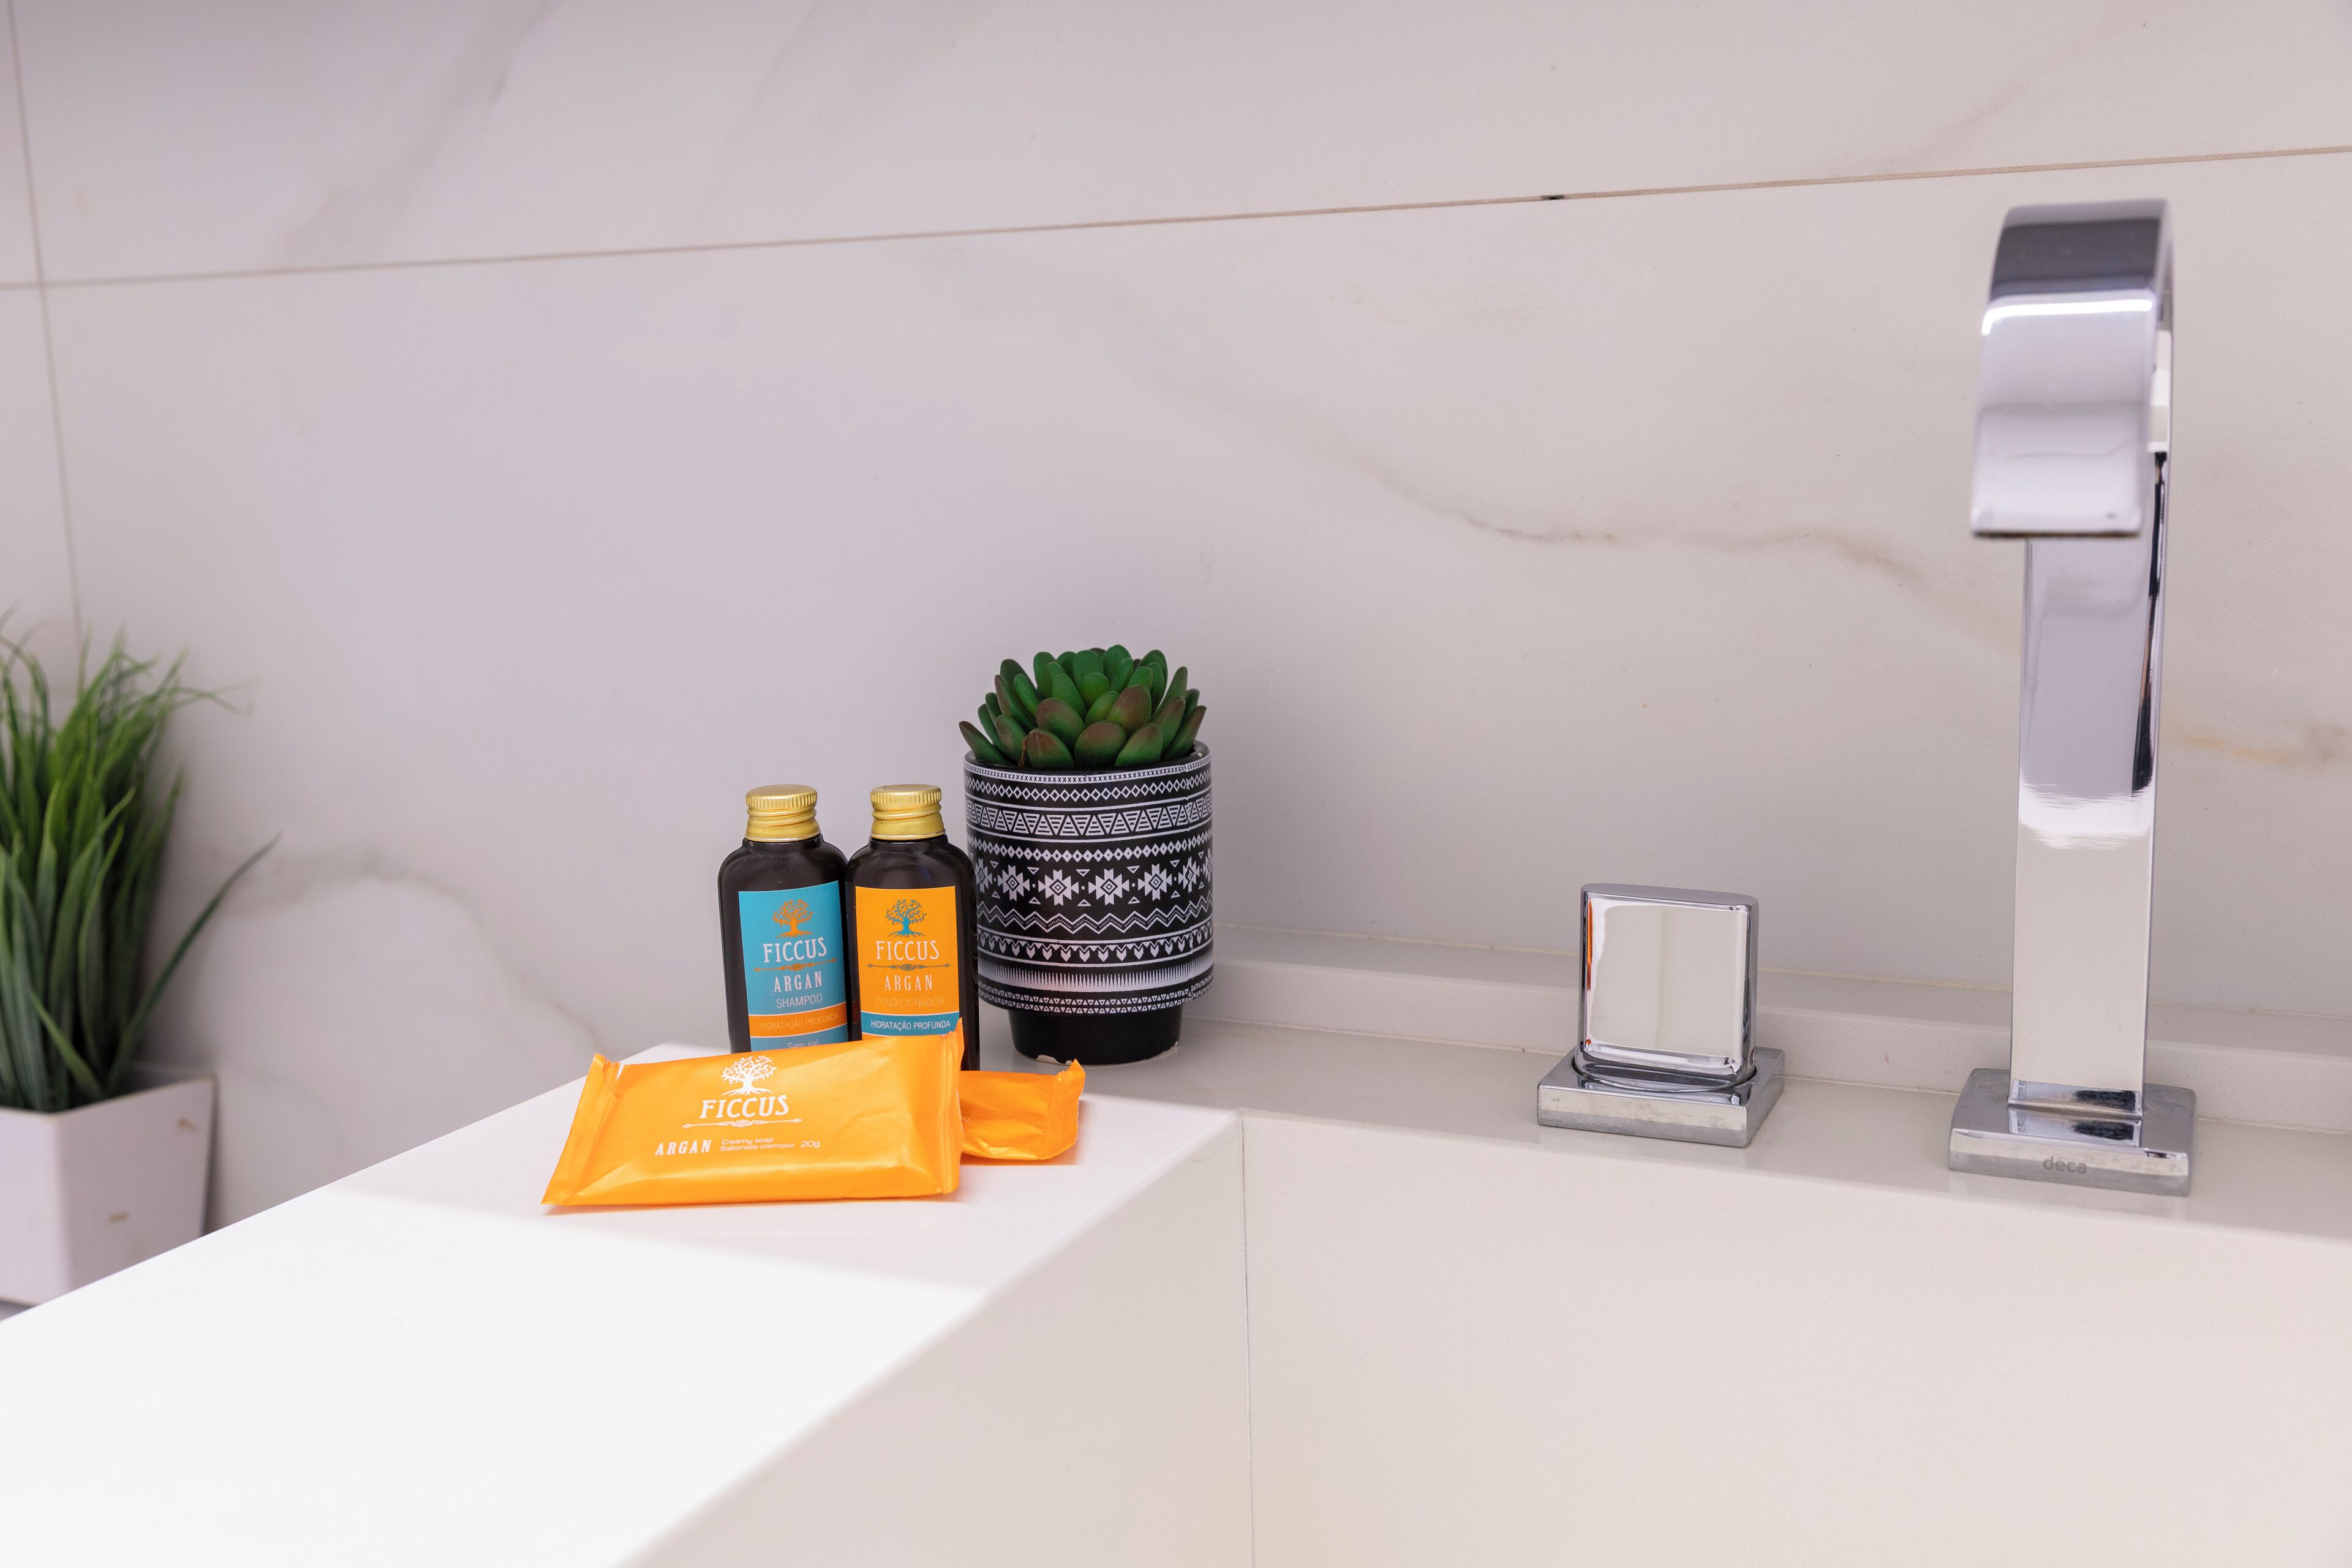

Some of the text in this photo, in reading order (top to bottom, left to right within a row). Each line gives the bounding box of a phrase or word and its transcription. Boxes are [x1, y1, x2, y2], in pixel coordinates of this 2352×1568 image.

[763, 937, 827, 963] FICCUS
[876, 940, 940, 961] FICCUS
[774, 971, 823, 992] ARGAN
[884, 974, 933, 991] ARGAN
[776, 993, 823, 1009] SHAMPOO
[875, 997, 944, 1008] CONDICIONADOR
[760, 1012, 839, 1030] HIDRATAÇÃO PROFUNDA
[870, 1019, 951, 1031] HIDRATAÇÃO PROFUNDA
[699, 1095, 790, 1119] FICCUS
[654, 1139, 712, 1156] ARGAN
[800, 1140, 821, 1148] 20g
[2043, 1156, 2087, 1174] deca
